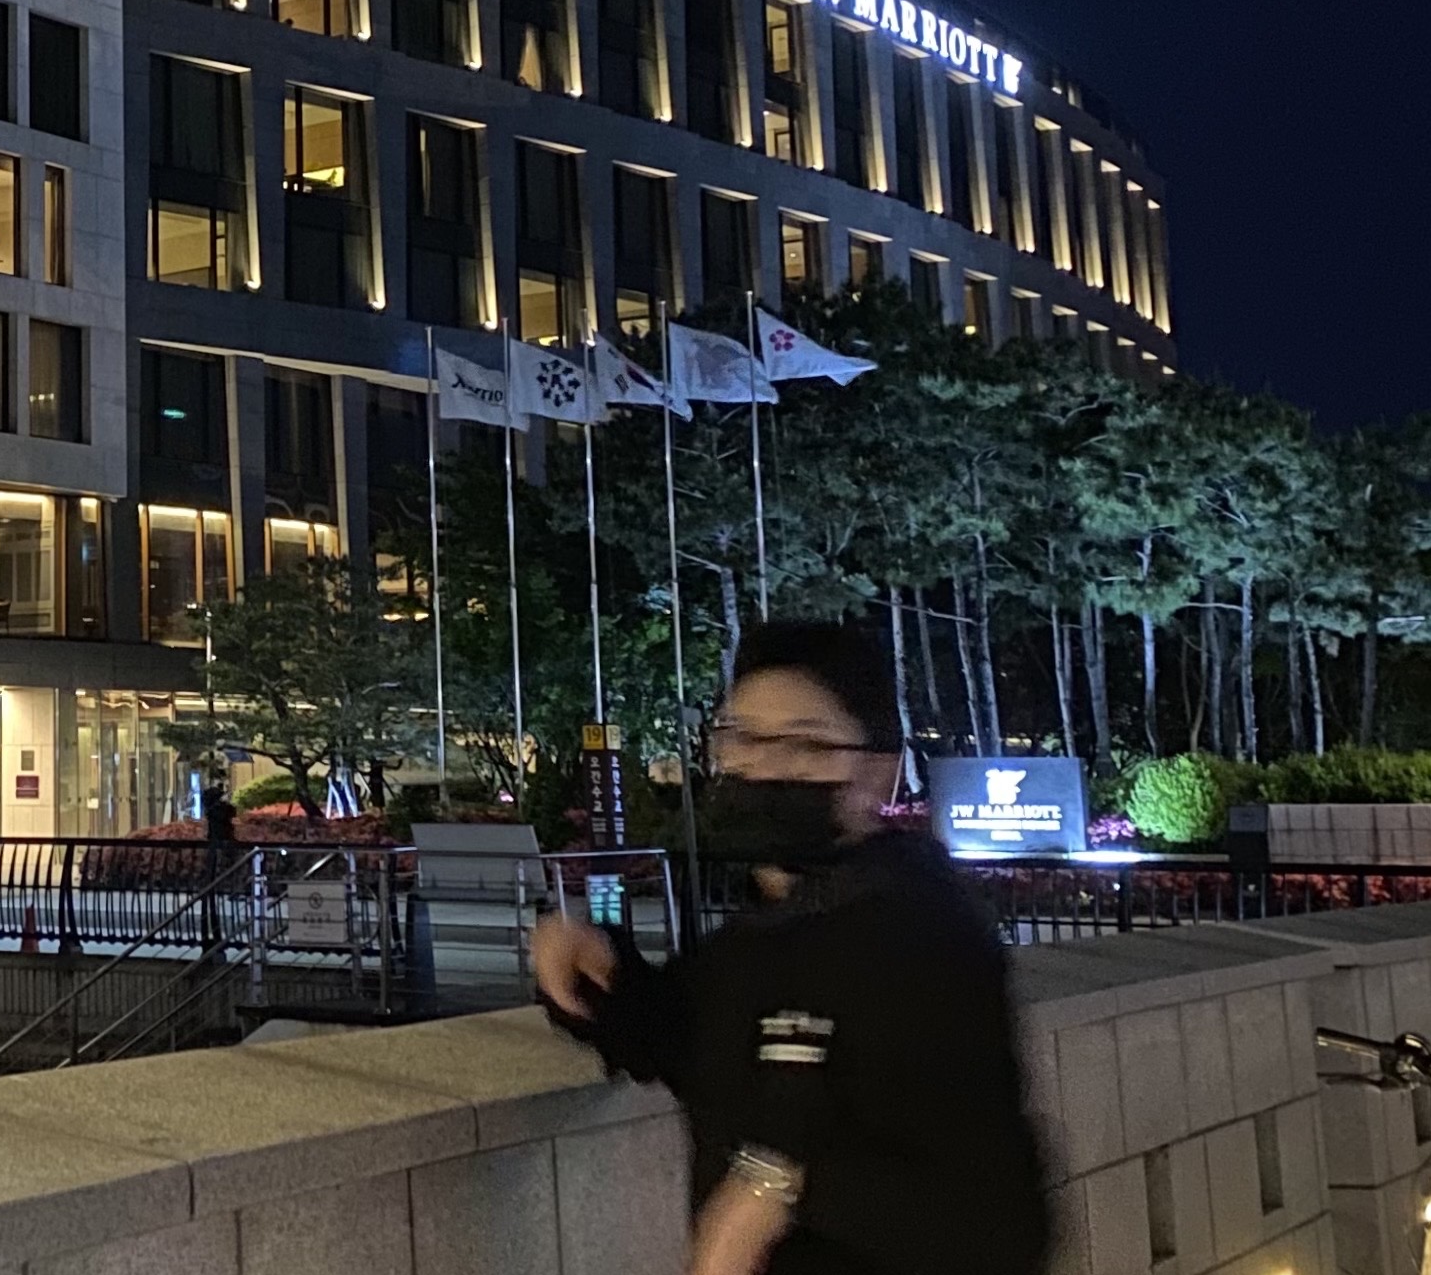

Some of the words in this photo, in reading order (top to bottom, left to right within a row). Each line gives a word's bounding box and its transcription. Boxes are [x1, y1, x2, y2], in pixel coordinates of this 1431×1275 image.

[585, 726, 602, 742] 19
[590, 756, 603, 812] 오간수교
[950, 804, 975, 818] JW
[978, 804, 1063, 819] MARRIOTT
